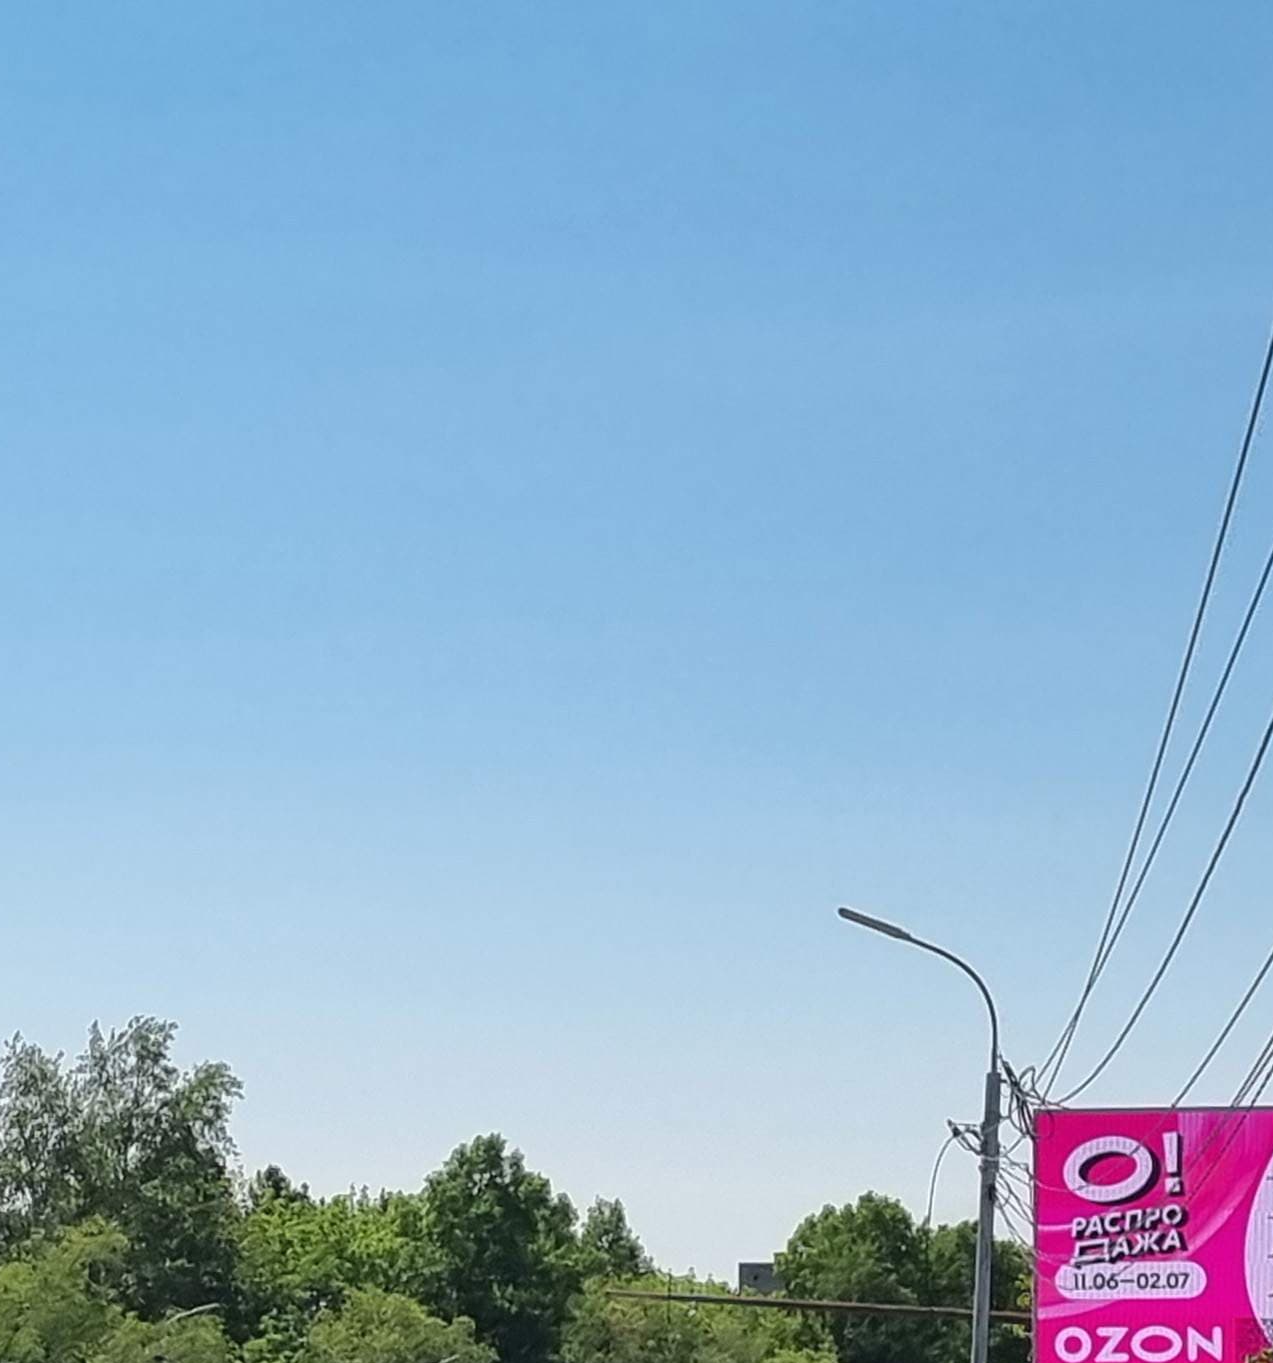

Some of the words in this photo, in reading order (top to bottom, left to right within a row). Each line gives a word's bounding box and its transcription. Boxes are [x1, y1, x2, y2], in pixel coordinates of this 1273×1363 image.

[1071, 1204, 1185, 1238] РАСПРО
[1070, 1229, 1185, 1267] ДАЖА
[1054, 1325, 1223, 1363] OZON
